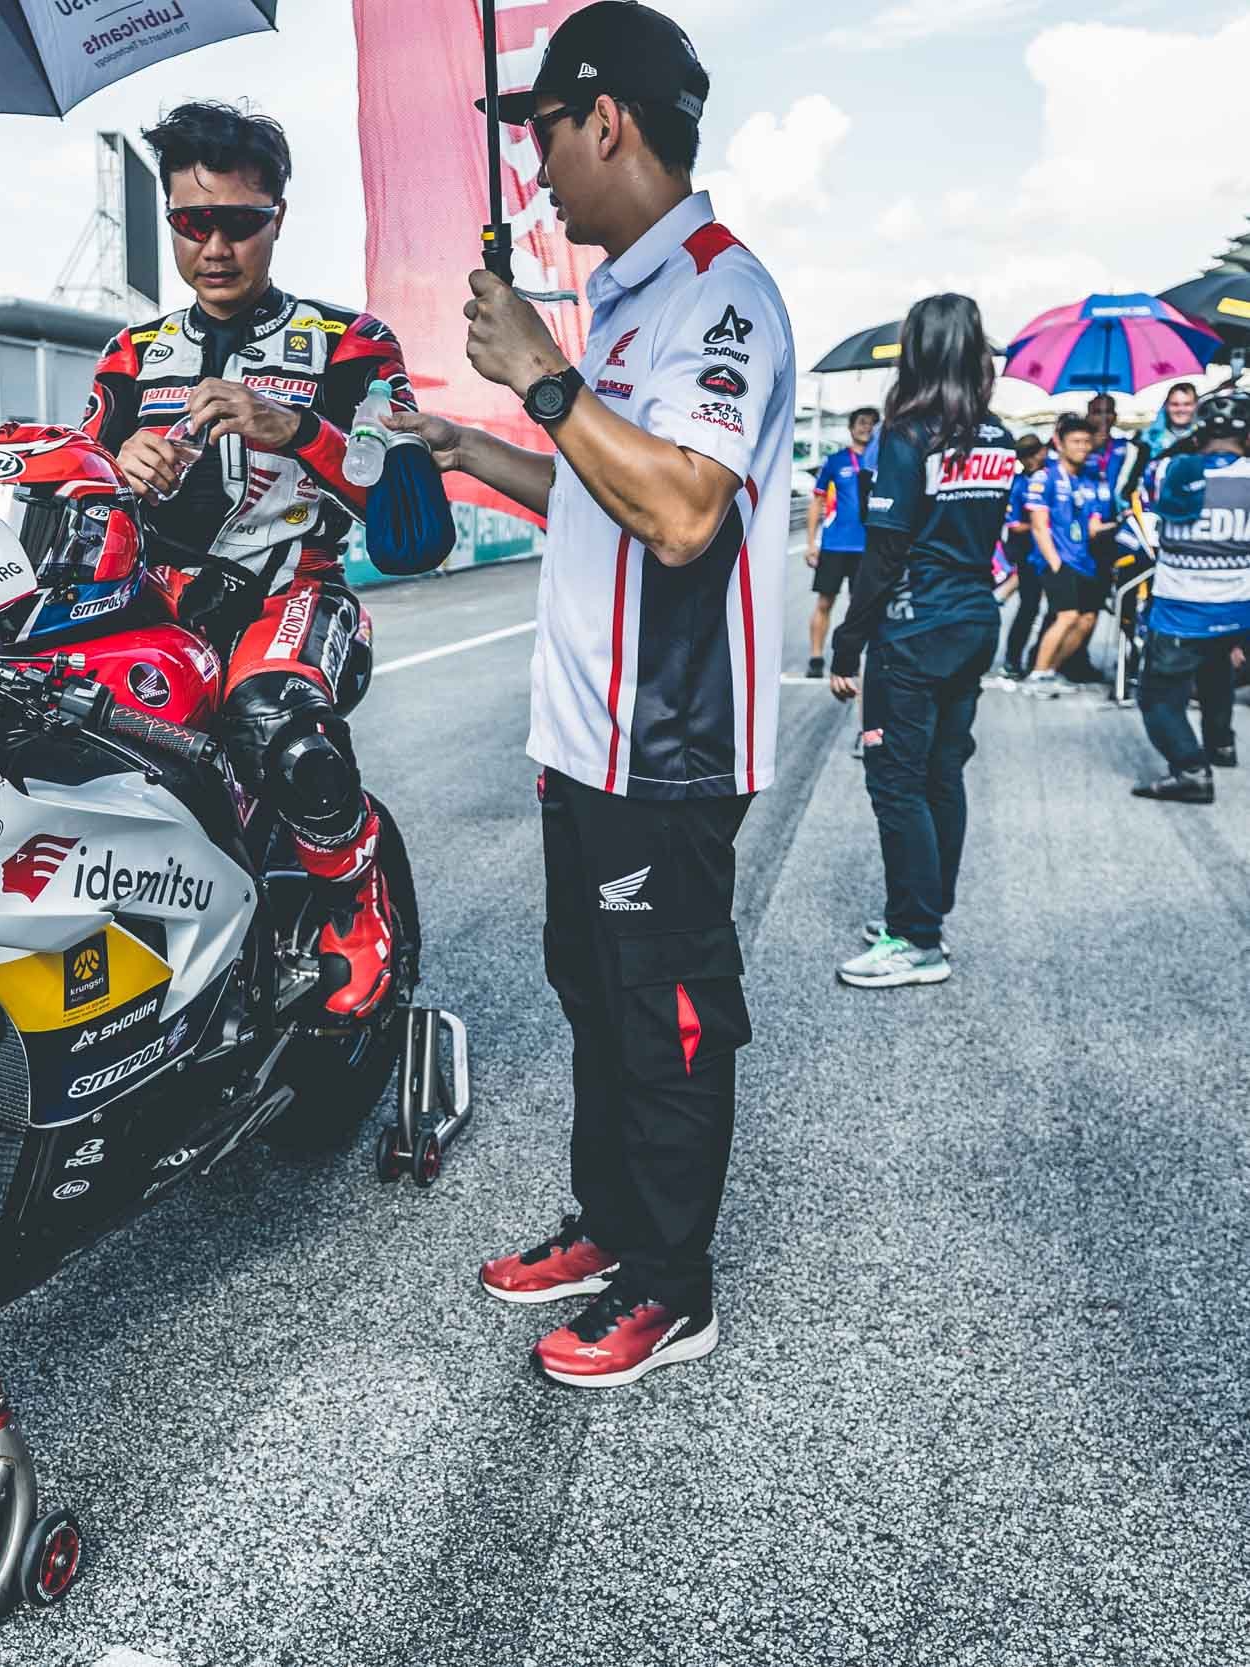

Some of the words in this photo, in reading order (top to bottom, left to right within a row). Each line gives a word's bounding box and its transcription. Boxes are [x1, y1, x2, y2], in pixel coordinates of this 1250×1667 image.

[702, 346, 751, 365] SHOWA
[243, 375, 316, 396] Racing
[691, 411, 744, 436] CHAMPION
[71, 593, 122, 618] SITTIPOL
[276, 592, 312, 649] HONDA
[140, 688, 169, 700] HONDA
[73, 846, 214, 912] idemitsu
[599, 900, 654, 911] HONDA
[99, 997, 158, 1041] SHOWA
[68, 1036, 166, 1098] SITTIPOL
[64, 1153, 105, 1169] RCB
